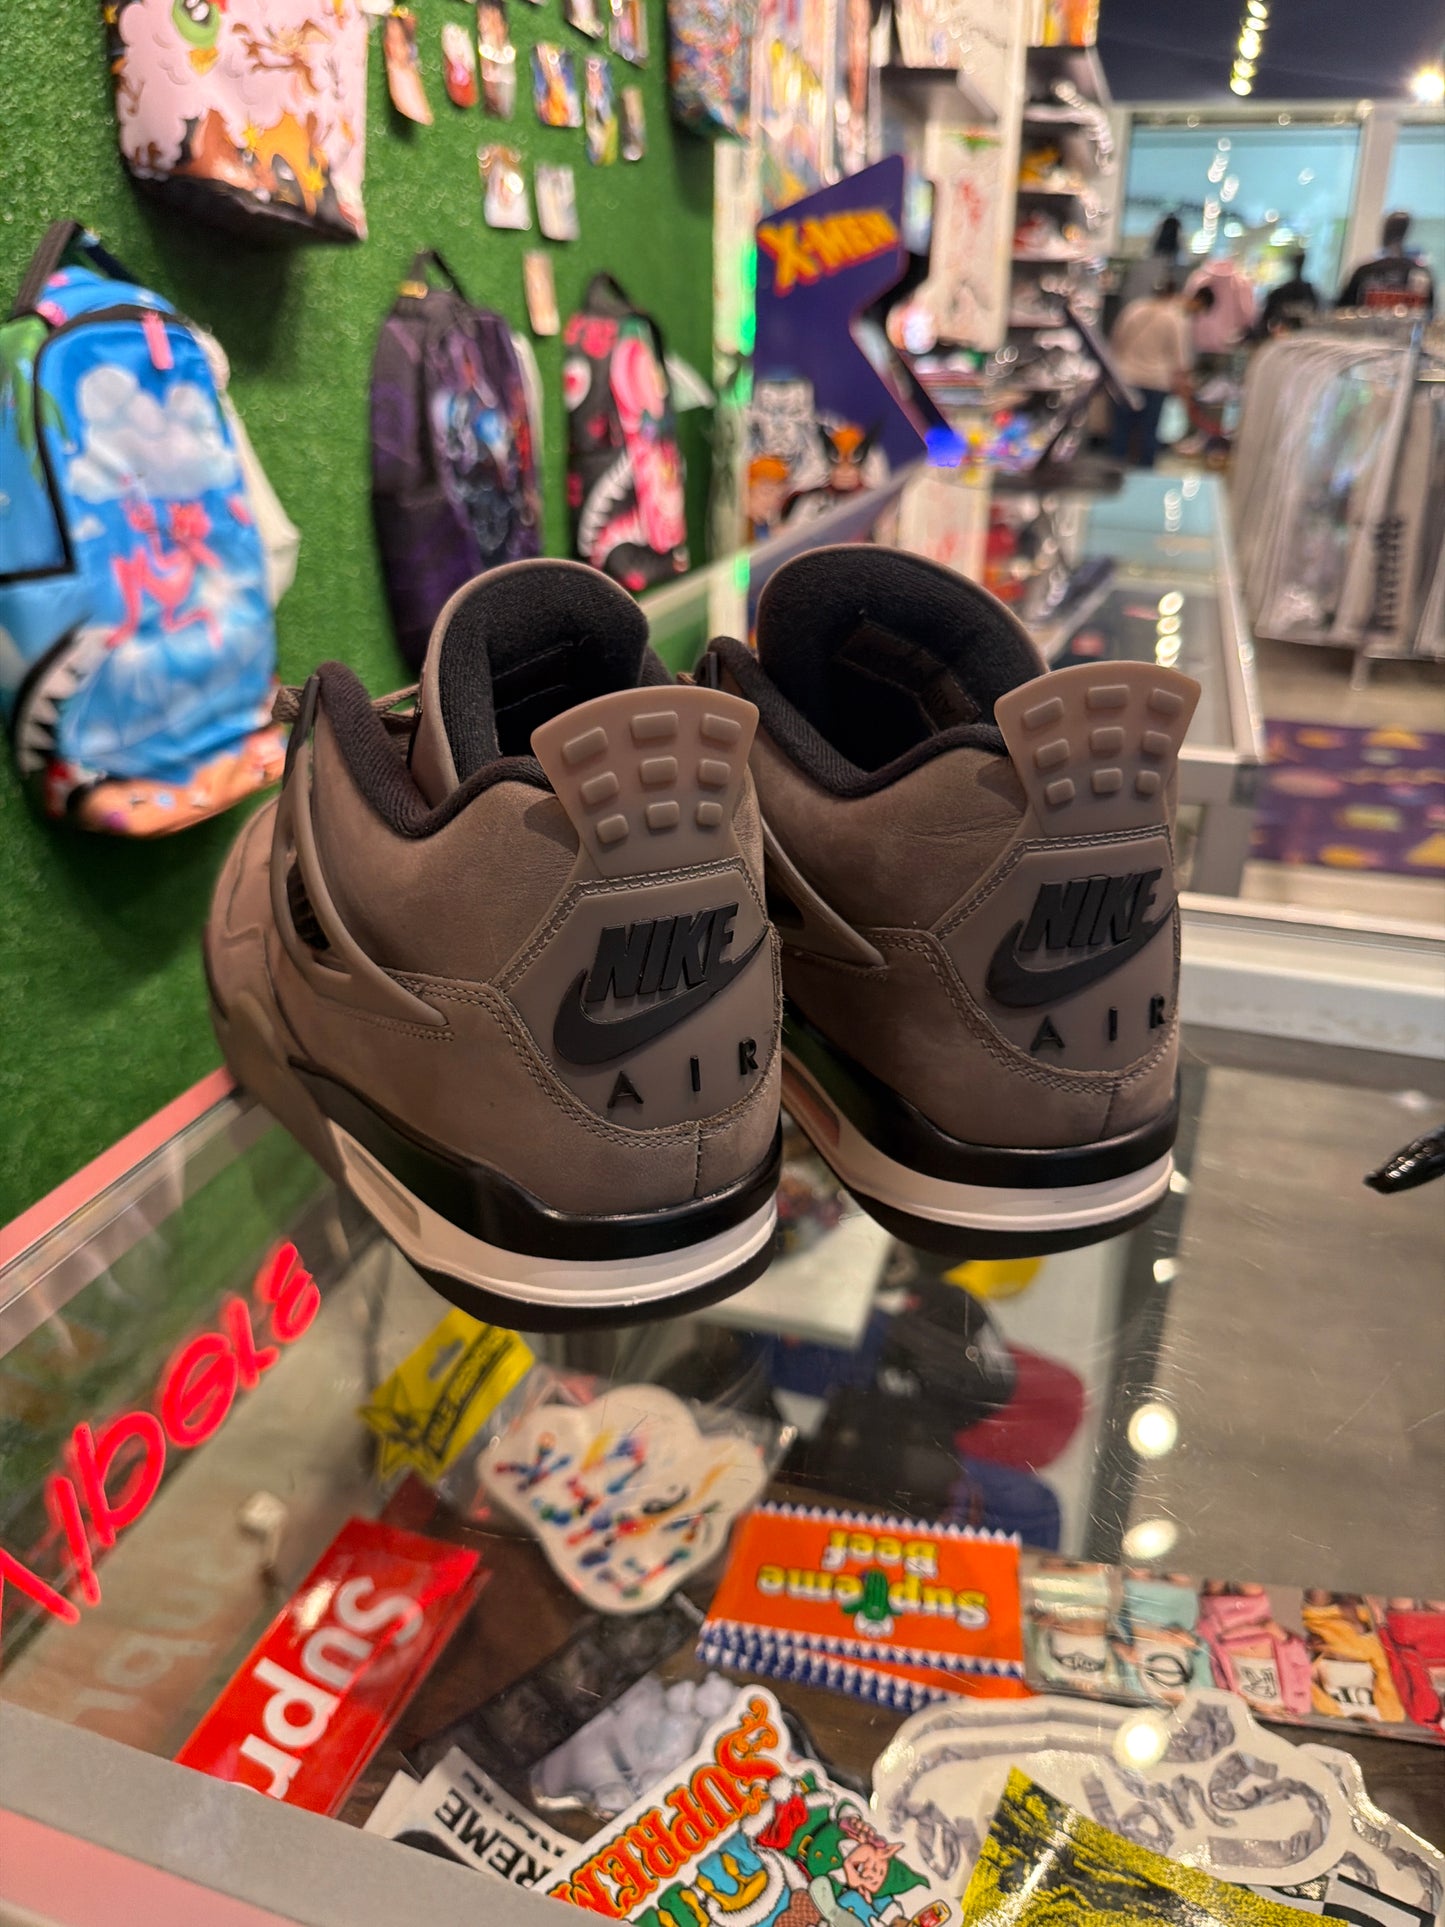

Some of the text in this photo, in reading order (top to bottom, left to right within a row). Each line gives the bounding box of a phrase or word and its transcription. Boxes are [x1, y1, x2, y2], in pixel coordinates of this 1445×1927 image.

[756, 211, 899, 298] X-MEN
[1019, 868, 1163, 951] NIKE
[585, 902, 739, 1003] NIKE
[1029, 993, 1166, 1051] AIR
[607, 1039, 759, 1109] AIR
[821, 1530, 940, 1580] Beef
[240, 1576, 424, 1799] Supr
